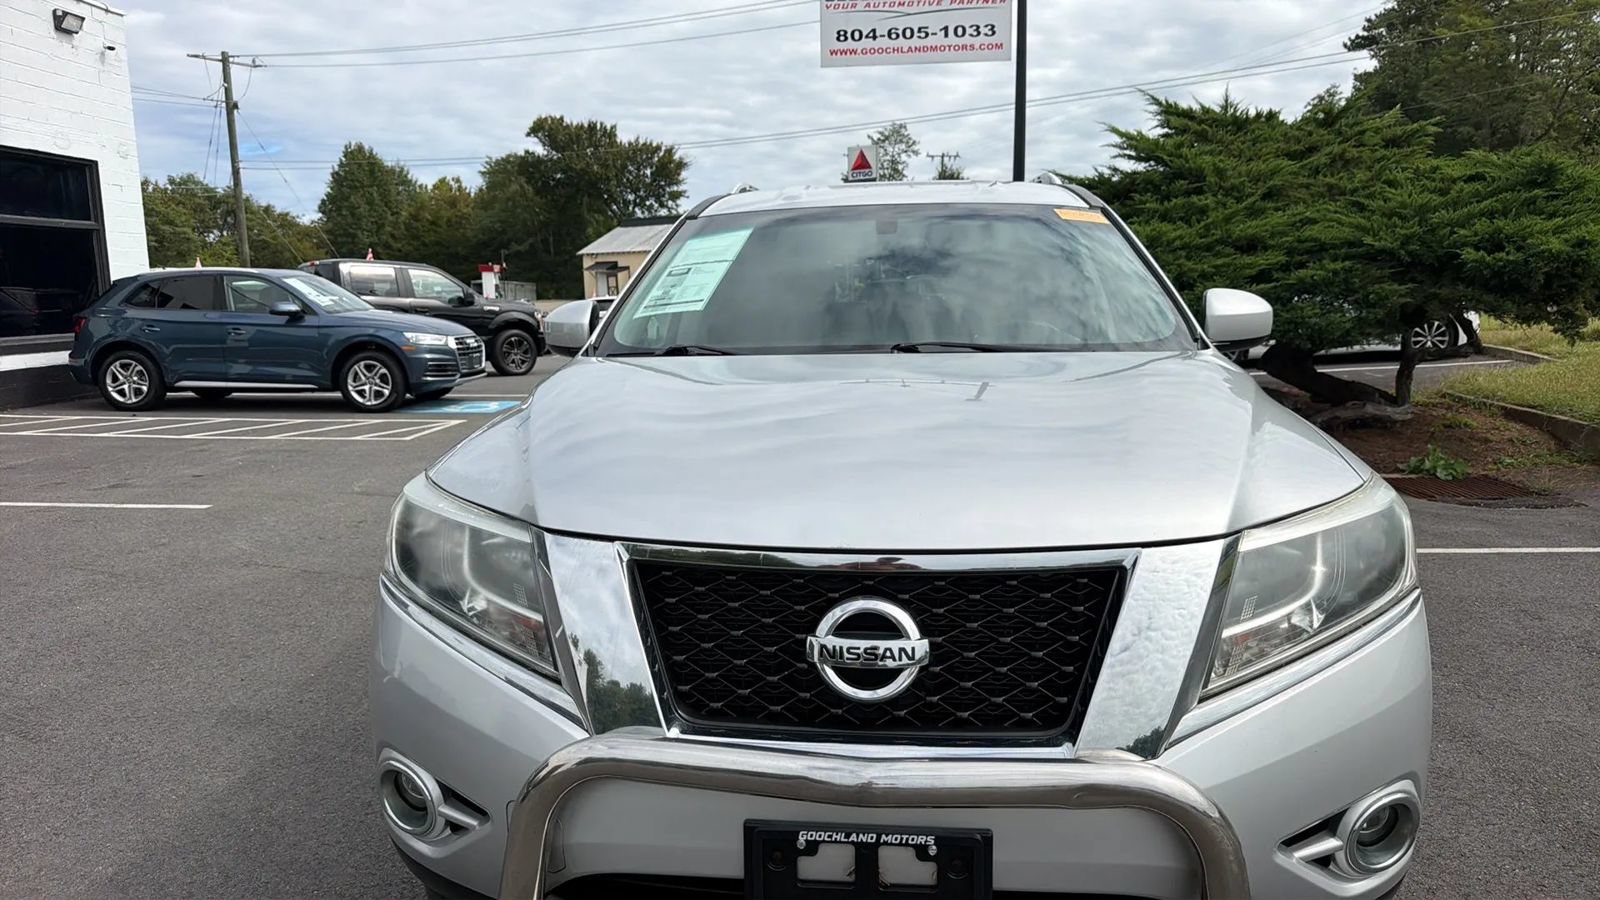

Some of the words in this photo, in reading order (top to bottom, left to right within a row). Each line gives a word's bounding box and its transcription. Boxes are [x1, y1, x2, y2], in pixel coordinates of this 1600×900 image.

[825, 2, 858, 10] YOUR
[863, 0, 944, 9] AUTOMOTIVE
[835, 23, 997, 43] 804-605-1033
[829, 42, 1004, 57] WWW.GOOCHLANDMOTORS.COM
[851, 170, 873, 179] CITGO
[819, 643, 916, 663] NISSAN
[798, 830, 877, 843] GOOCHLAND
[880, 833, 935, 845] MOTORS
